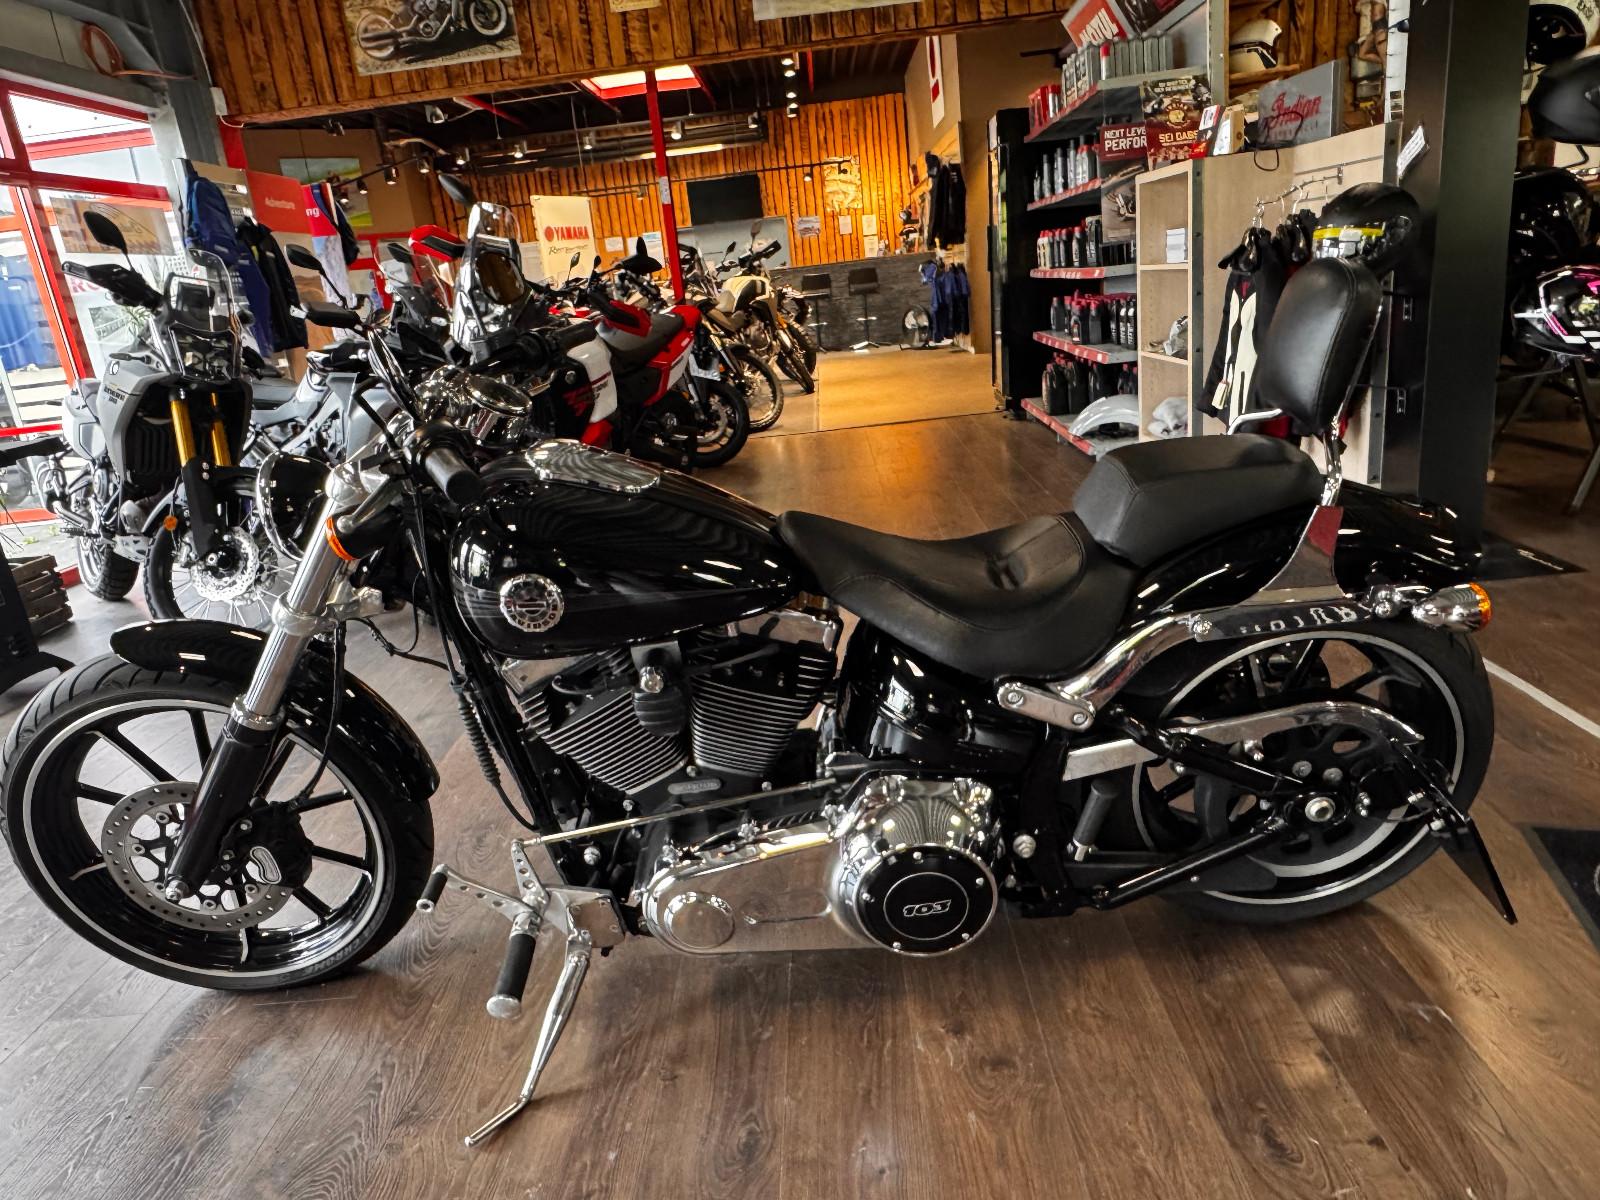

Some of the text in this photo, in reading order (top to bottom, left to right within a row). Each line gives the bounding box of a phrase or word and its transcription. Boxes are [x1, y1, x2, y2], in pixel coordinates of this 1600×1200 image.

[1080, 7, 1119, 47] MOTUL
[1104, 128, 1125, 140] NEXT
[1159, 133, 1174, 143] SEI
[554, 226, 590, 241] YAMAHA
[903, 899, 952, 917] 103
